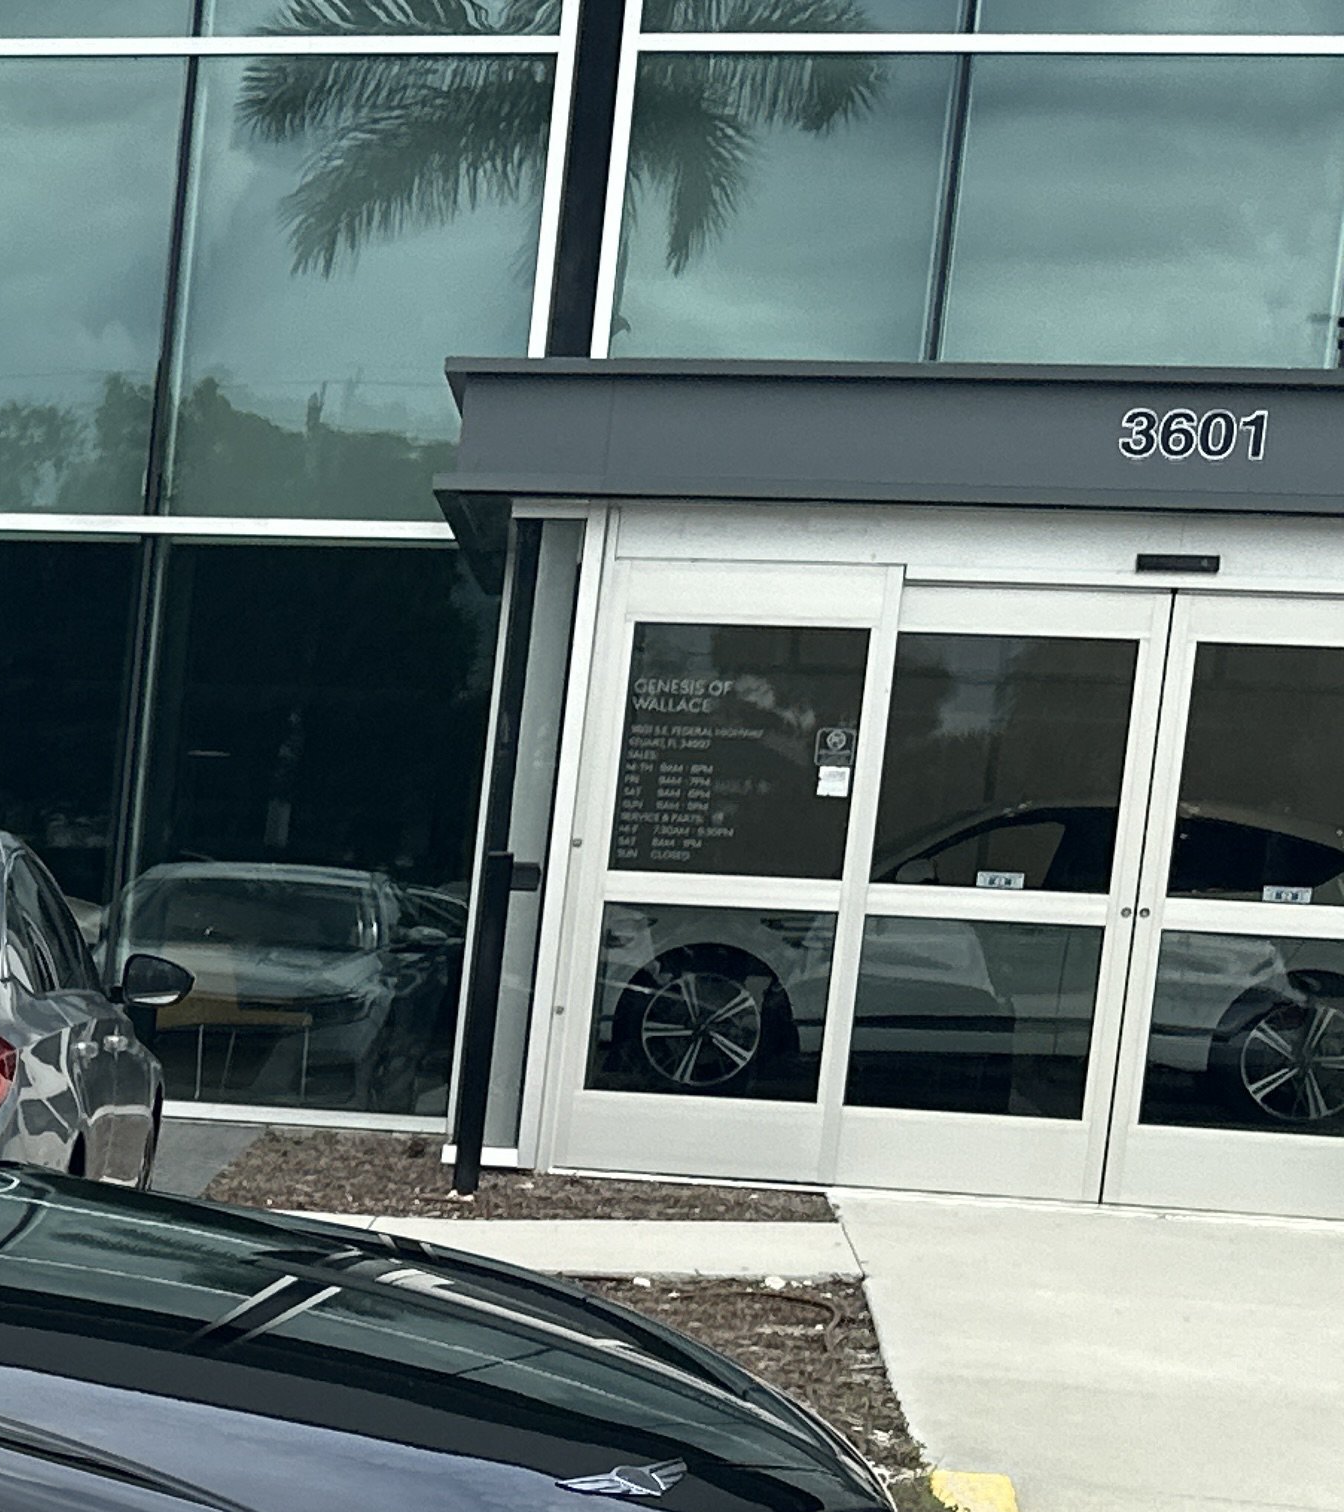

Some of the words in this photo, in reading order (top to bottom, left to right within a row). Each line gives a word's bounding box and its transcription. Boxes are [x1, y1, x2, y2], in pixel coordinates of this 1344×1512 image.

[1119, 408, 1269, 461] 3601
[633, 678, 705, 696] GENESIS
[708, 681, 736, 697] OF
[631, 697, 712, 713] WALLACE
